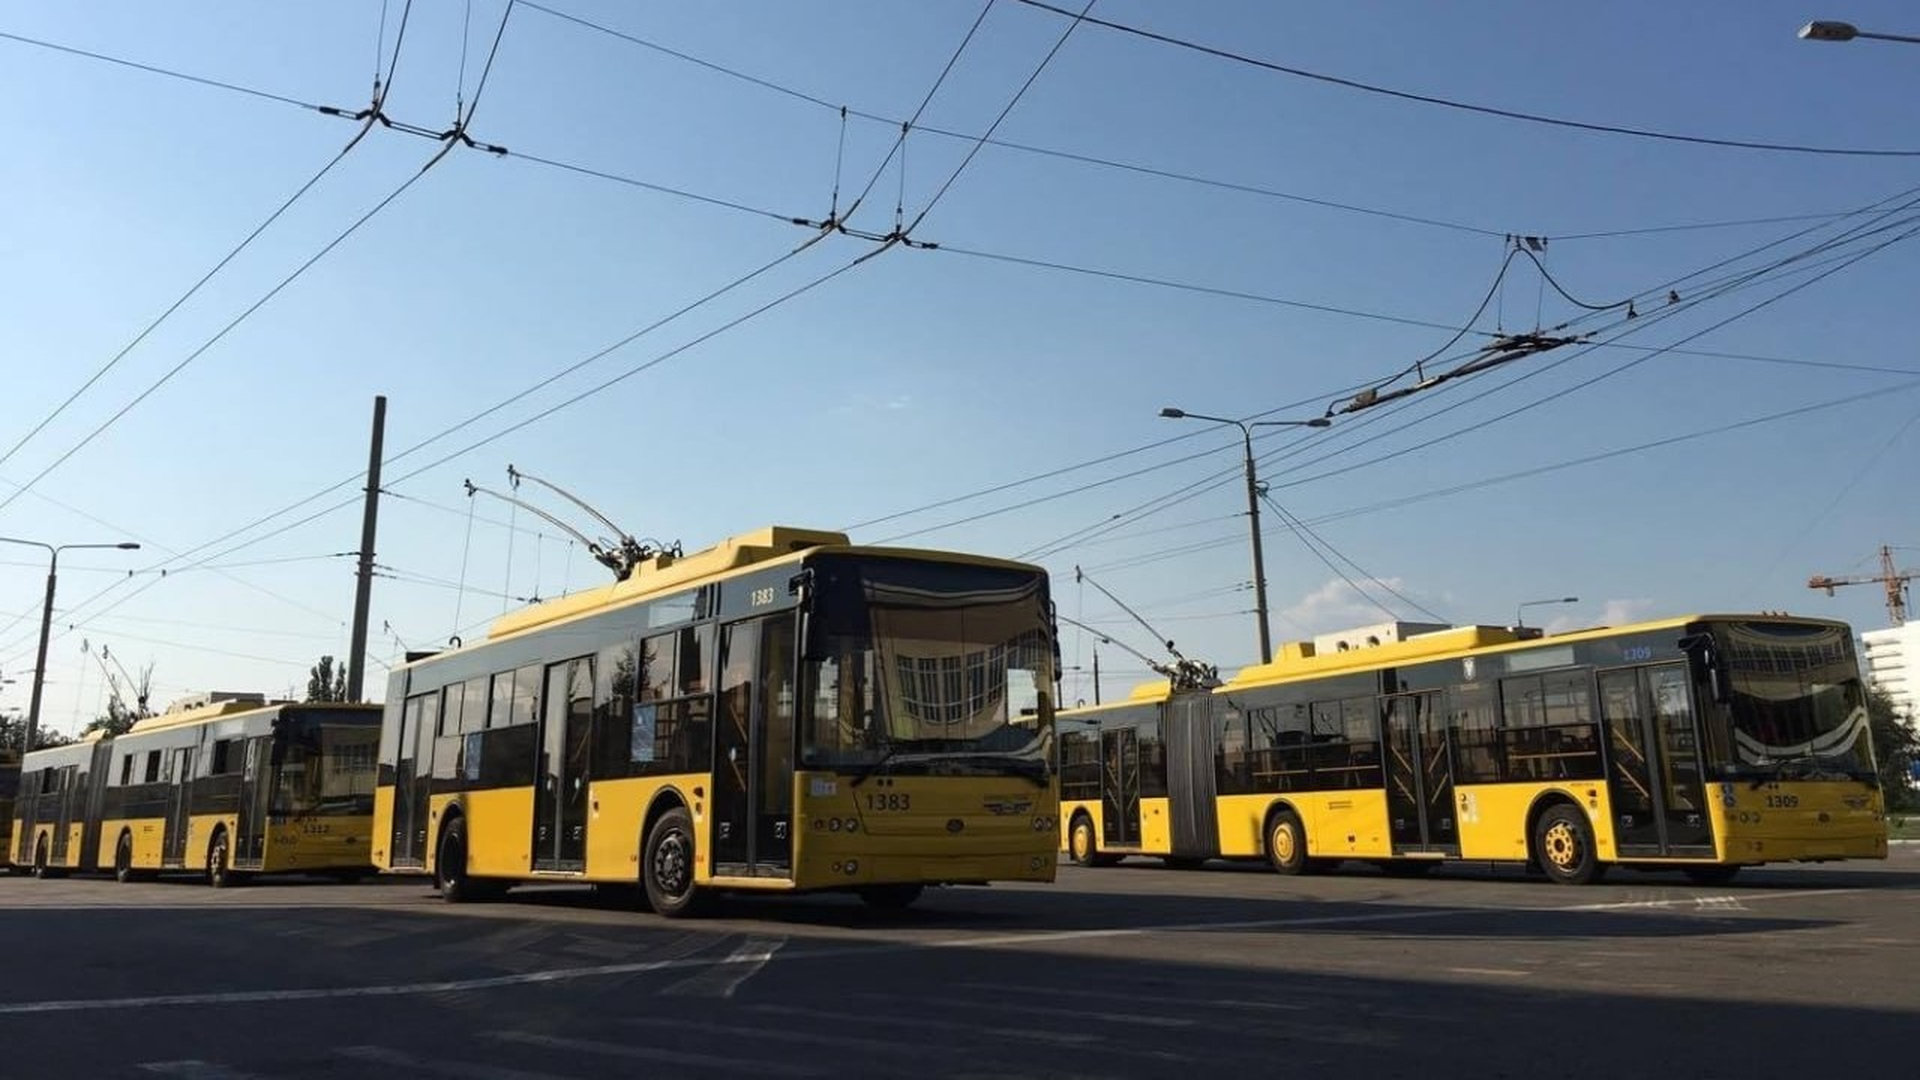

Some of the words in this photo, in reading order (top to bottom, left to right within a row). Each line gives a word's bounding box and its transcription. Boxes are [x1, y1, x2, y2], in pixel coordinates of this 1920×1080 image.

[751, 587, 774, 606] 1383
[1623, 646, 1651, 661] 1309
[866, 793, 911, 811] 1383
[1767, 795, 1799, 808] 1309
